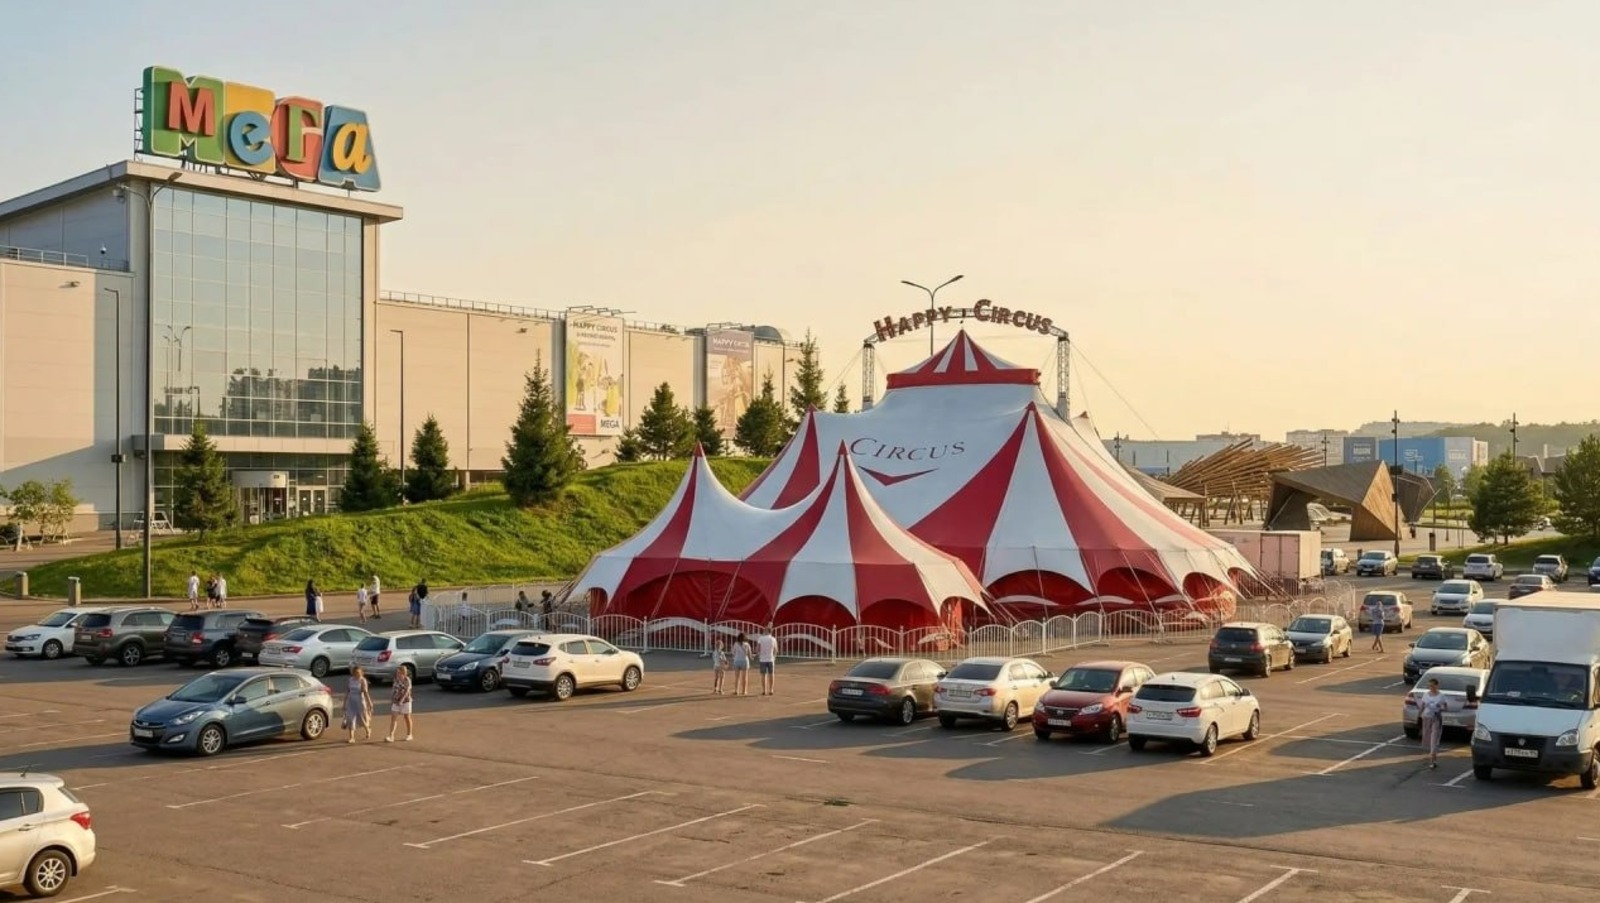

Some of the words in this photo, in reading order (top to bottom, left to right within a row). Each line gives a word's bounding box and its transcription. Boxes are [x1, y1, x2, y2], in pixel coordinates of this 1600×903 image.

[572, 320, 596, 331] HAPPY
[596, 324, 618, 333] CIRCUS
[873, 305, 952, 342] HAPPY
[973, 299, 1054, 335] CIRCUS
[600, 419, 620, 429] MEGA
[850, 437, 965, 460] CIRCUS
